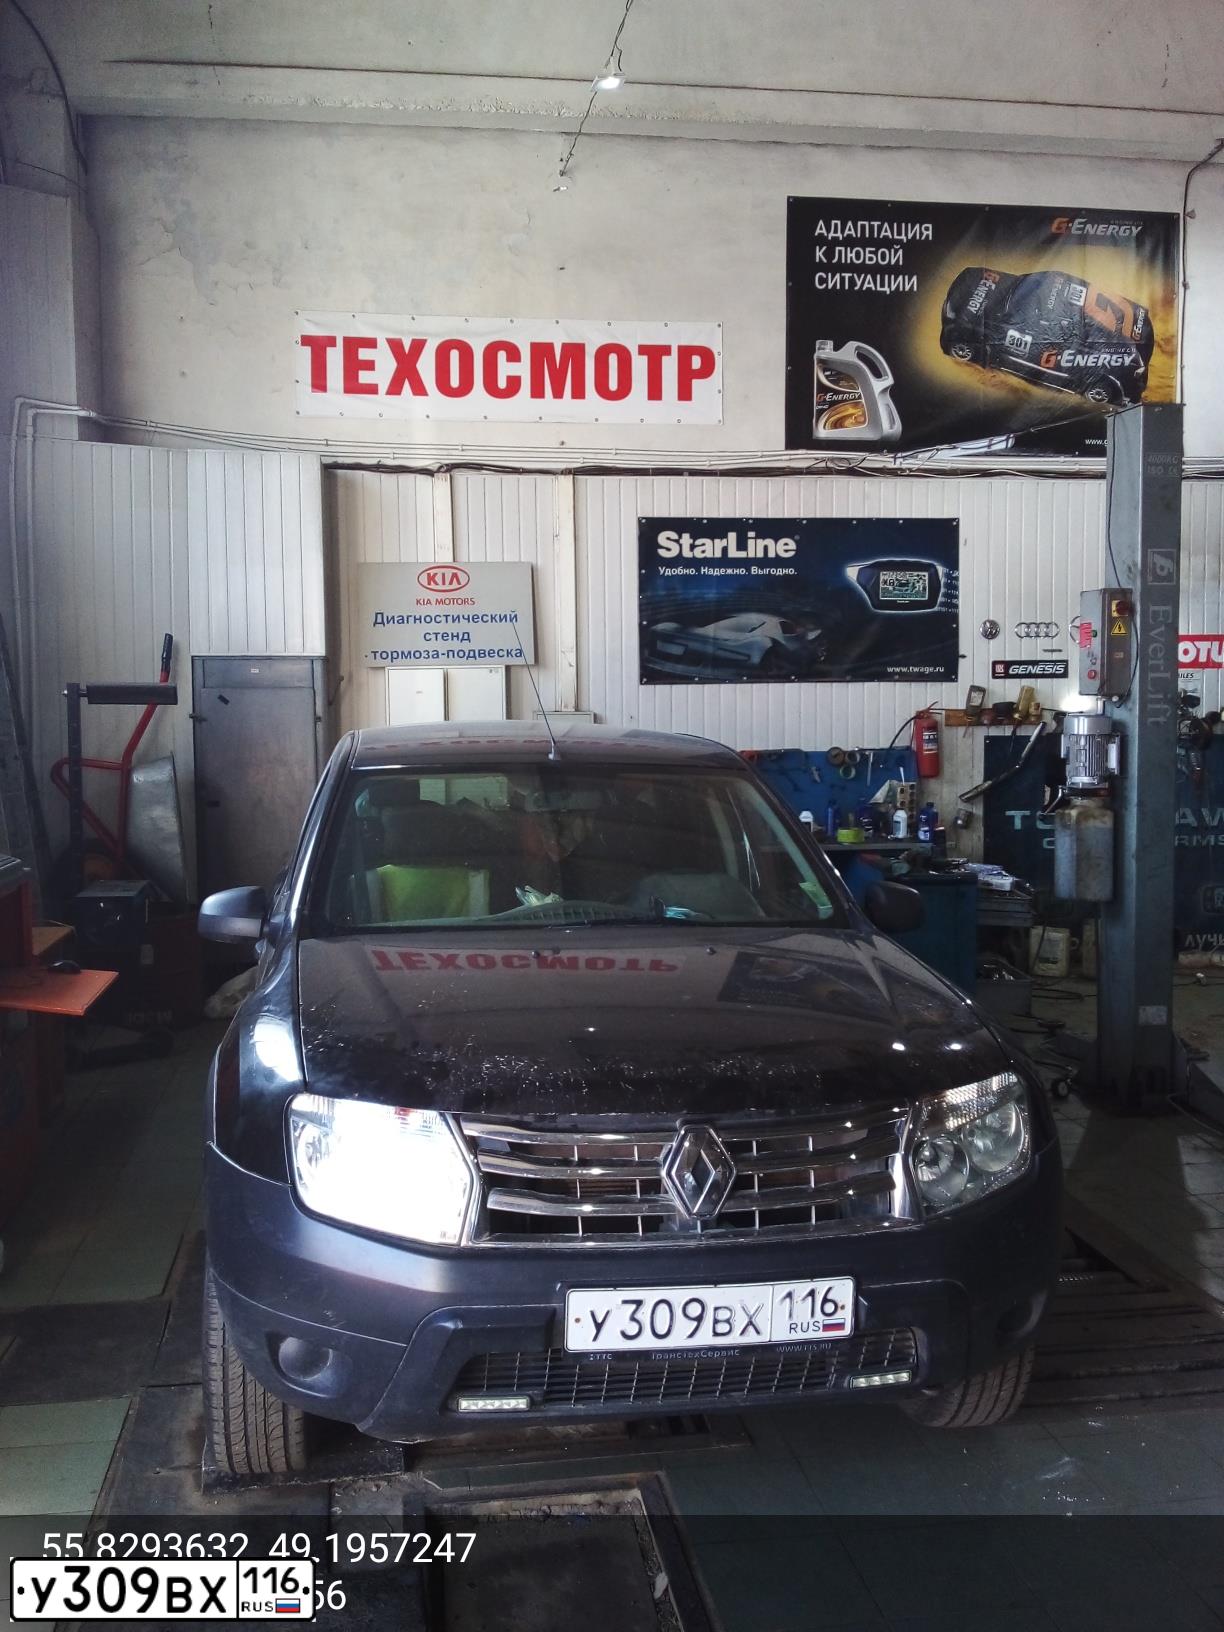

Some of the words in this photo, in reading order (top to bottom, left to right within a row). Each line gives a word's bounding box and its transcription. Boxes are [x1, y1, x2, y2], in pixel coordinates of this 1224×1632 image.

[814, 219, 933, 243] АДАПТАЦИЯ
[815, 246, 827, 263] К
[831, 244, 903, 265] ЛЮБОЙ
[814, 272, 918, 295] СИТУАЦИИ
[300, 334, 716, 402] ТЕХОСМОТР
[657, 530, 797, 558] StarLine
[426, 572, 462, 586] KIA
[658, 566, 698, 576] Удобно.
[701, 566, 748, 575] Надежно.
[751, 566, 798, 575] Выгодно.
[416, 598, 432, 606] KIA
[435, 597, 476, 606] MOTORS
[373, 610, 518, 627] Диагностический
[424, 631, 471, 643] стенд
[371, 647, 524, 662] тормоза-подвеска
[1008, 664, 1066, 674] GENESIS
[589, 1297, 765, 1342] У309ВХ
[778, 1286, 839, 1320] 116
[788, 1320, 821, 1334] RUS
